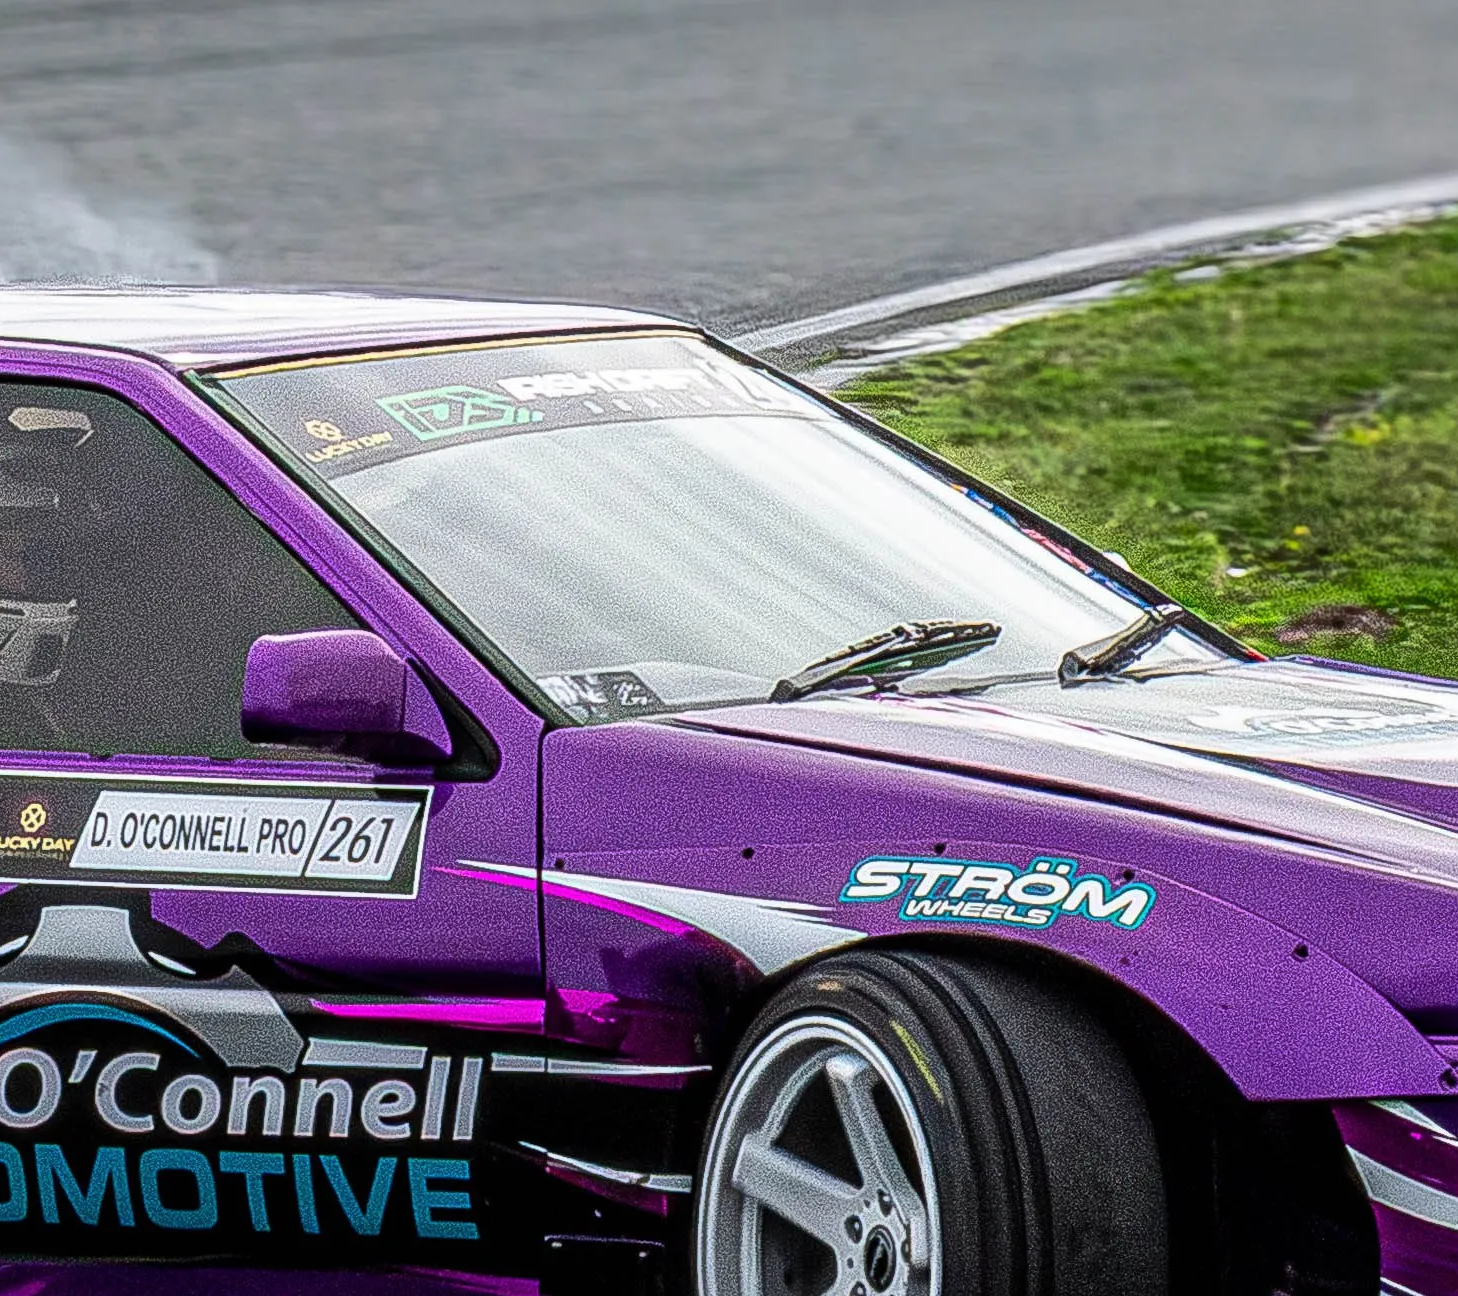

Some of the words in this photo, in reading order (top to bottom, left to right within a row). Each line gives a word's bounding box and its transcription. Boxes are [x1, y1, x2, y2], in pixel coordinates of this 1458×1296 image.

[42, 837, 76, 852] DAY
[90, 811, 111, 848] D.
[120, 812, 249, 853] O'CONNELL
[256, 817, 307, 855] PRO
[318, 816, 395, 864] 261
[847, 859, 1151, 926] STRÖM
[904, 897, 1052, 925] WHEELS
